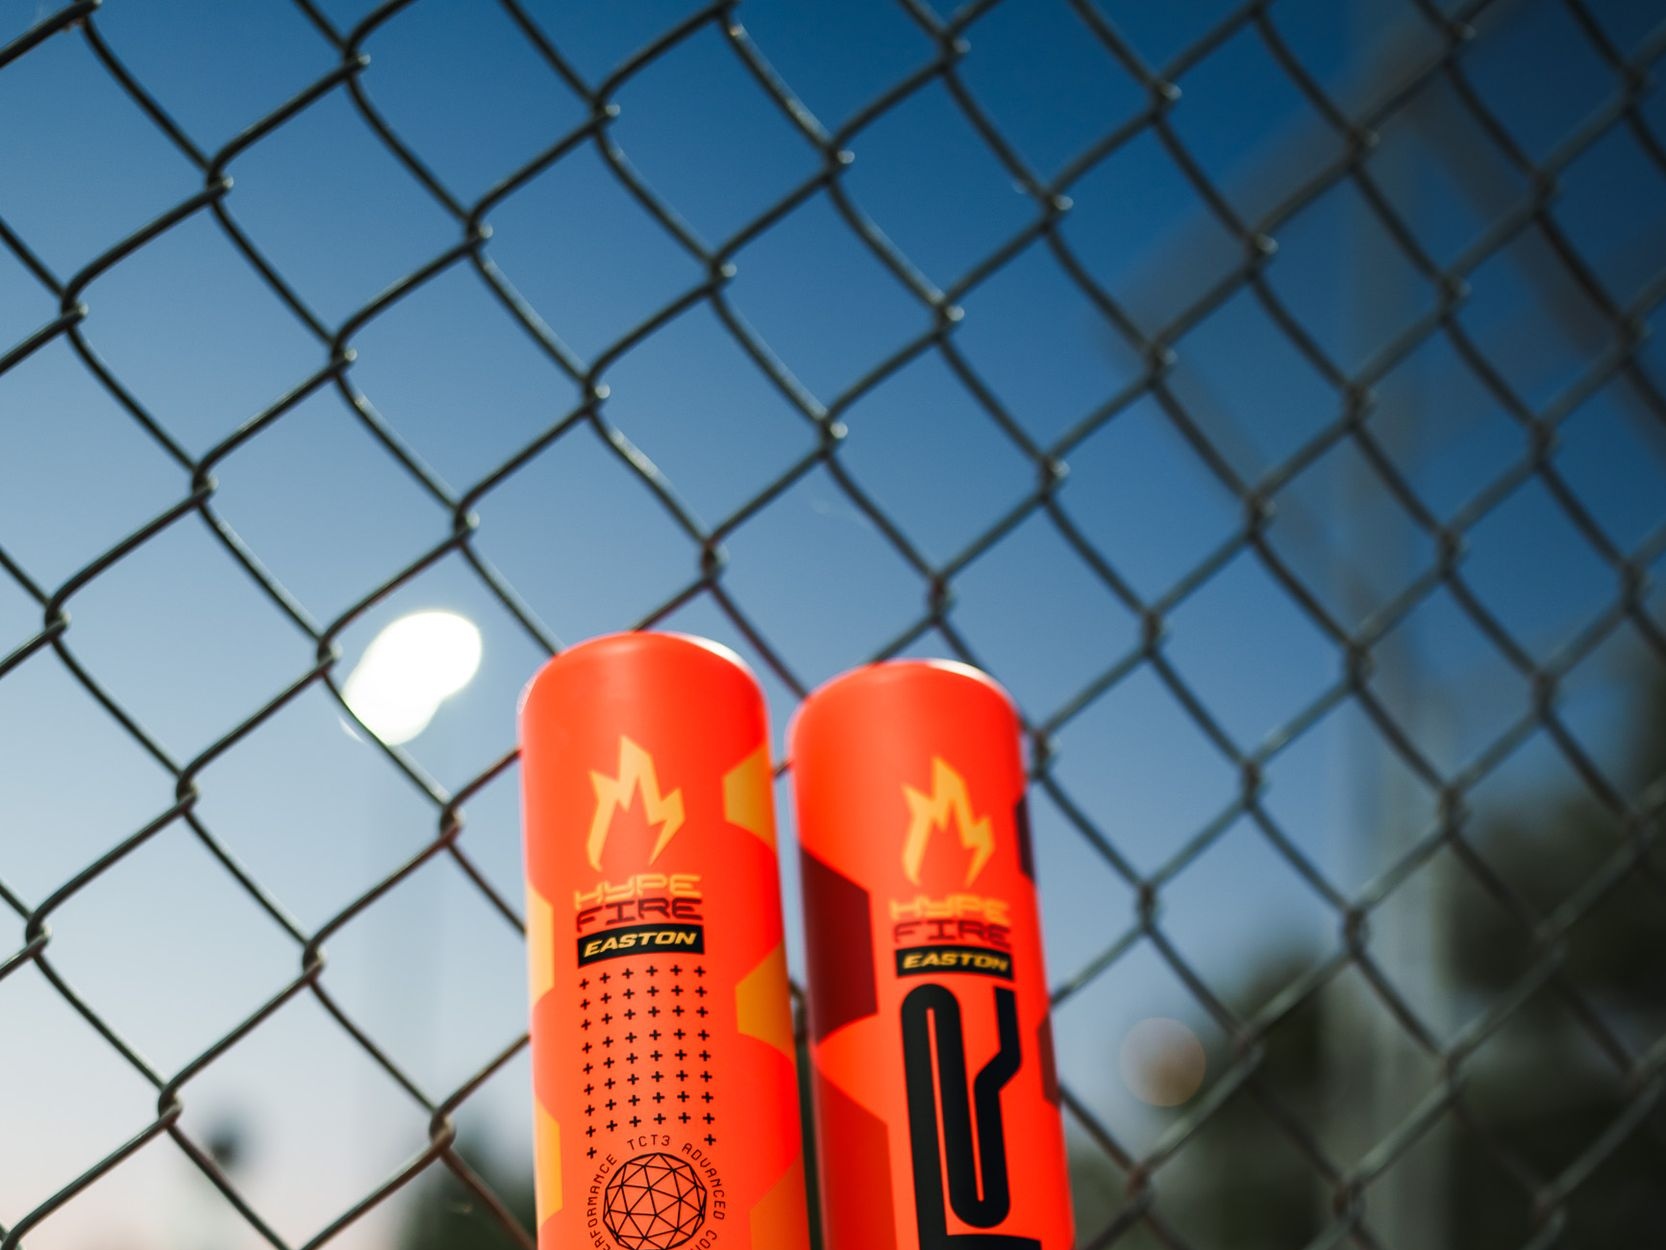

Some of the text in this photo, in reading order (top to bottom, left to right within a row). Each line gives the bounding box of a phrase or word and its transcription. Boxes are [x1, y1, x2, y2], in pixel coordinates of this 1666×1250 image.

[574, 874, 702, 910] HYPE
[577, 897, 702, 933] FIRE
[890, 894, 1010, 925] HYPE
[583, 931, 697, 958] EASTON
[893, 919, 1011, 950] FIRE
[903, 952, 1008, 971] EASTON
[626, 1134, 671, 1150] TCT3
[682, 1142, 726, 1220] ADVANCED
